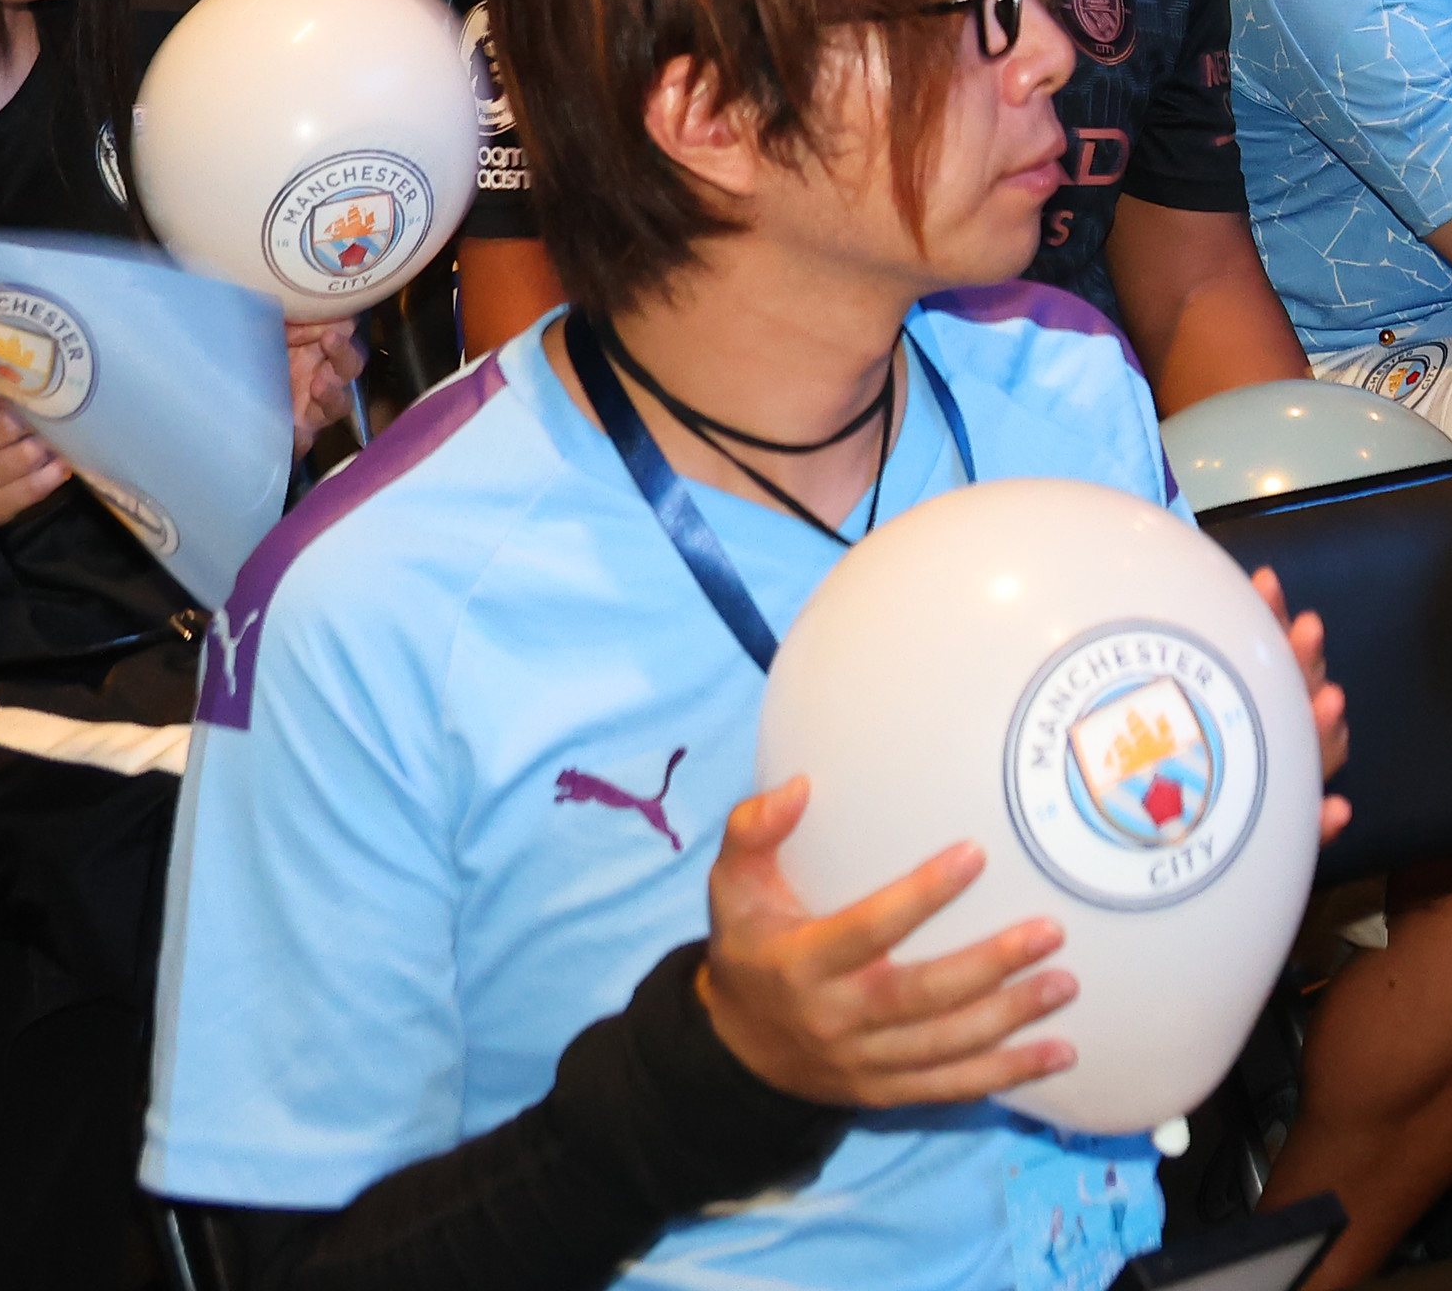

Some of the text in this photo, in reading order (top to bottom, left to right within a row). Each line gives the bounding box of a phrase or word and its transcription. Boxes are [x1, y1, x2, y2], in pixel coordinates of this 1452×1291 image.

[1094, 43, 1117, 56] CITY
[283, 166, 418, 226] MANCHESTER
[328, 272, 375, 293] CITY
[1030, 643, 1217, 773] MANCHESTER
[1148, 834, 1217, 889] CITY
